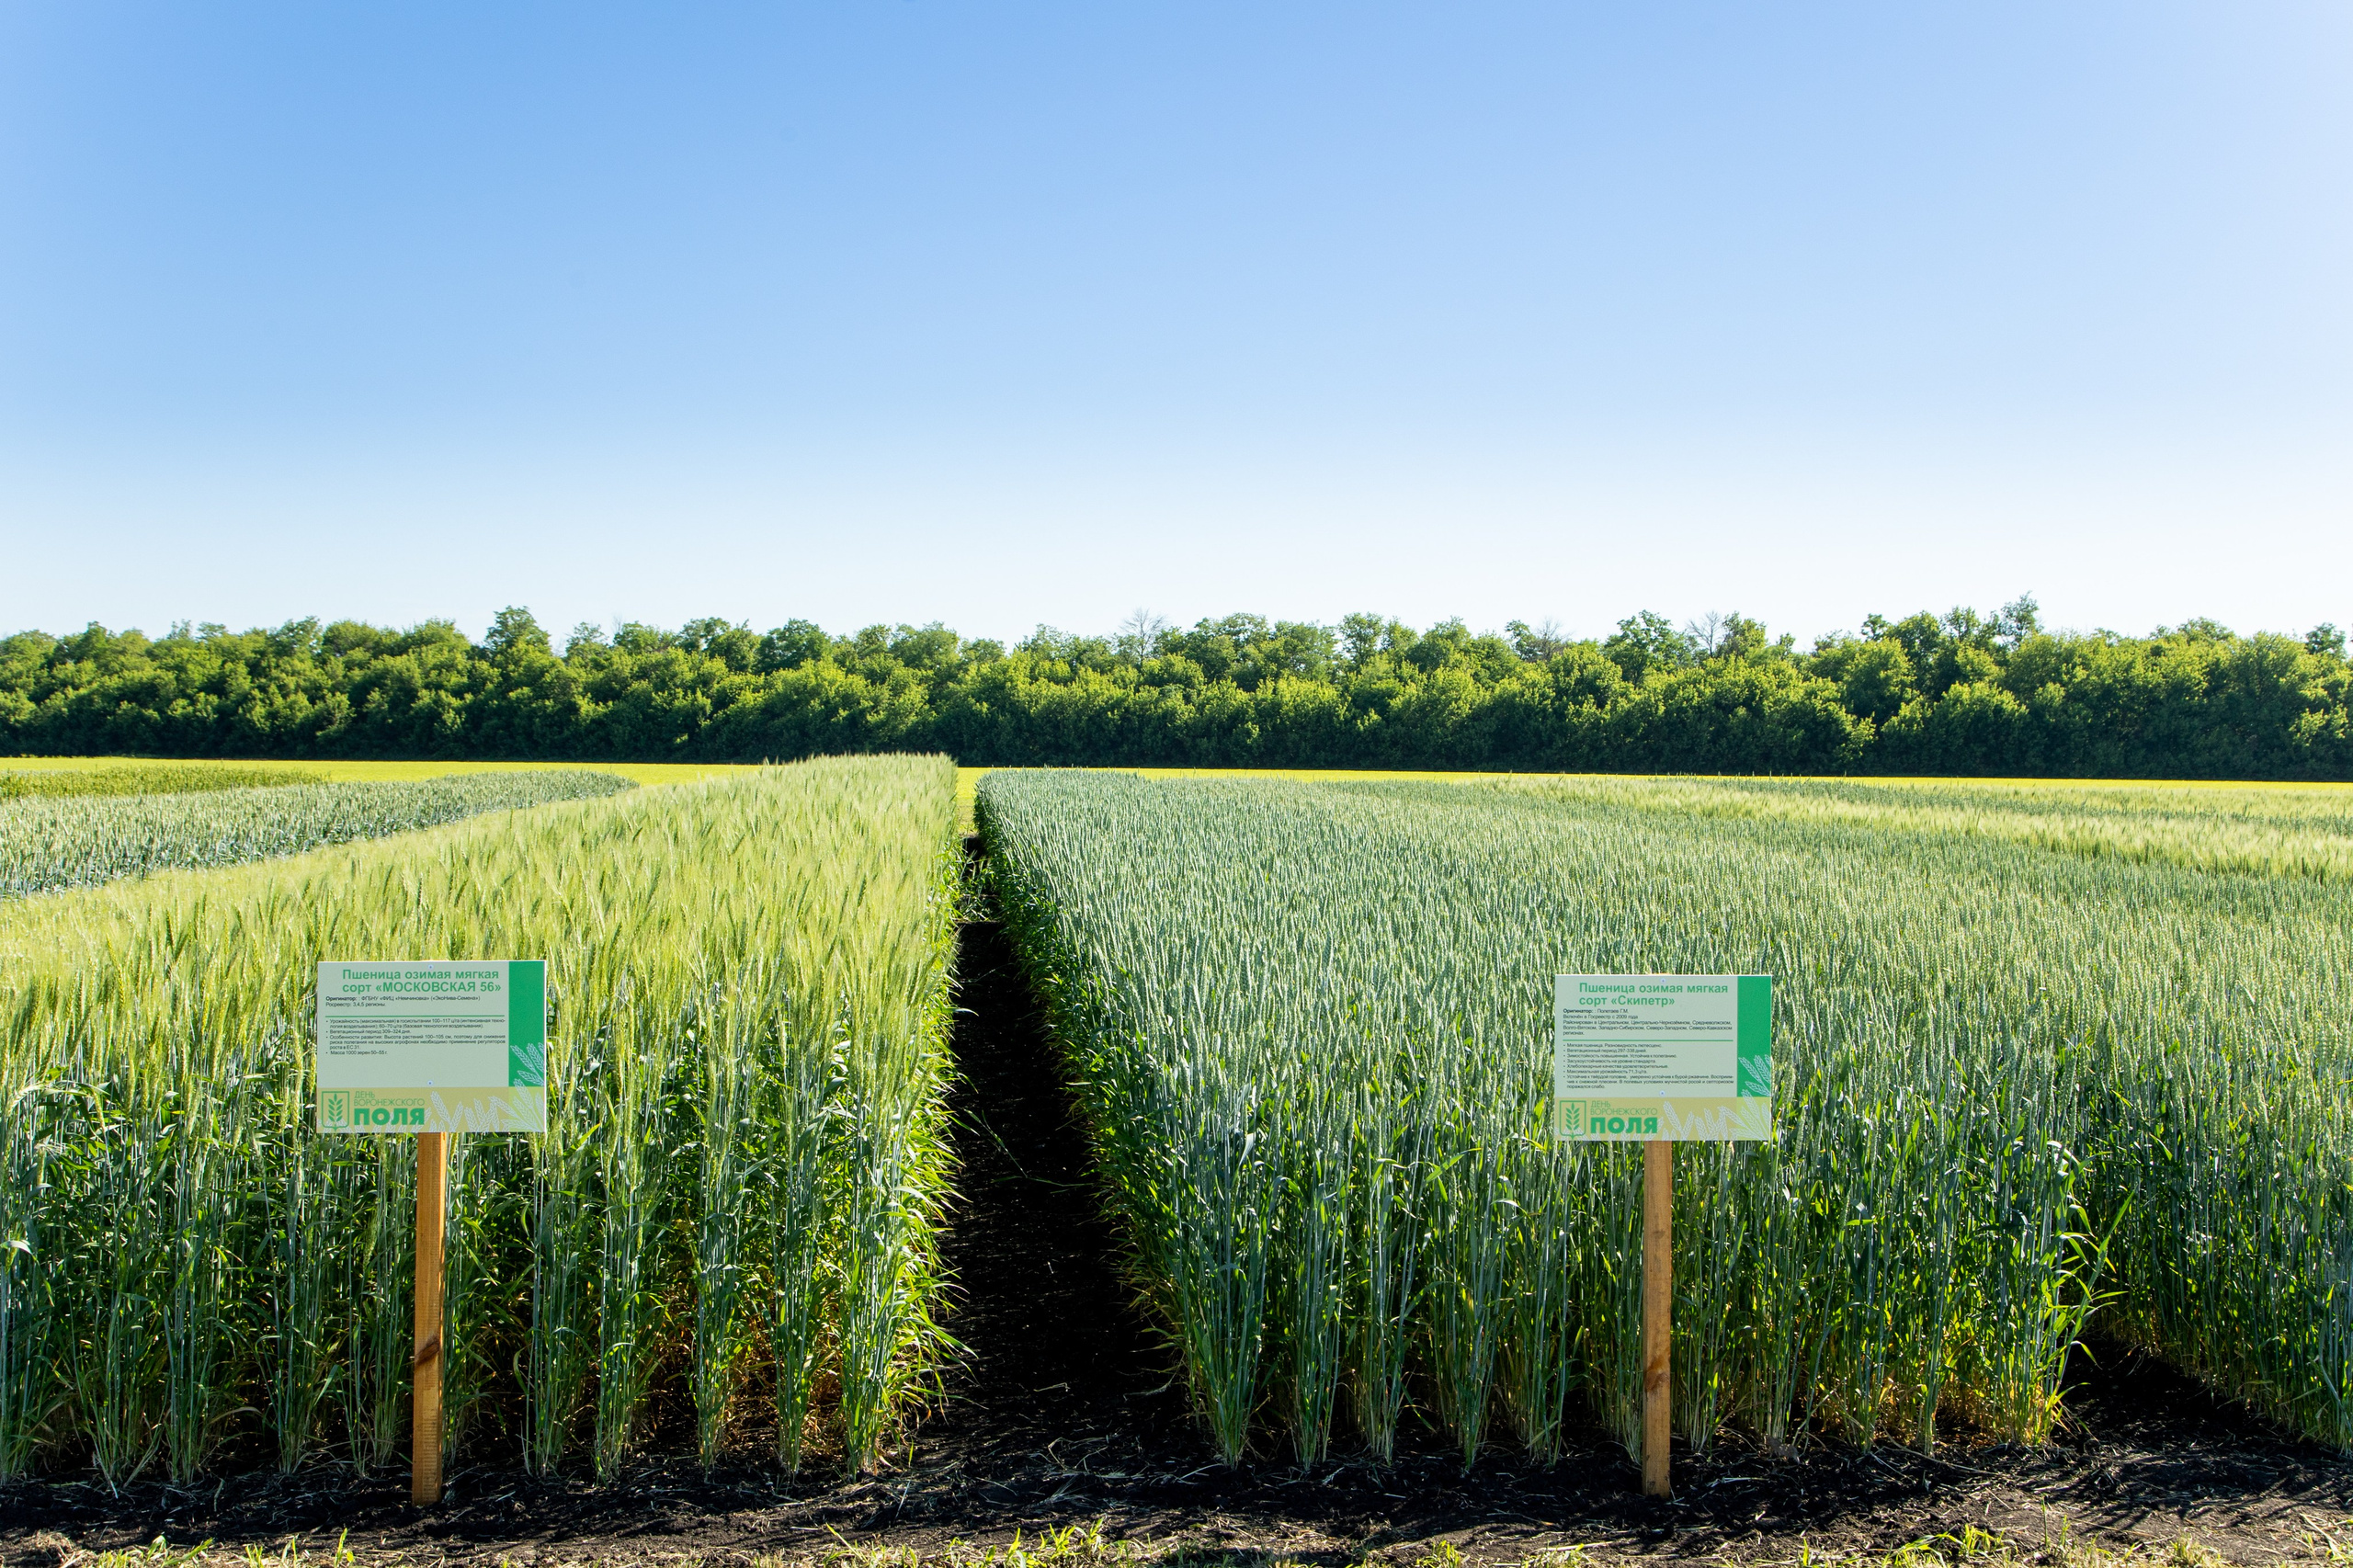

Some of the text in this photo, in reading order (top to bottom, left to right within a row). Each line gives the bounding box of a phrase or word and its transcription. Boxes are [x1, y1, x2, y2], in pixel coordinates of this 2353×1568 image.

[343, 969, 400, 980] Пшеница
[343, 982, 501, 994] сорт «МОСКОВСКАЯ 56»
[1579, 983, 1635, 994] Пшеница
[1579, 995, 1675, 1007] сорт «Скипетр»
[354, 1108, 424, 1125] ПОЛЯ
[1591, 1117, 1657, 1133] ПОЛЯ
